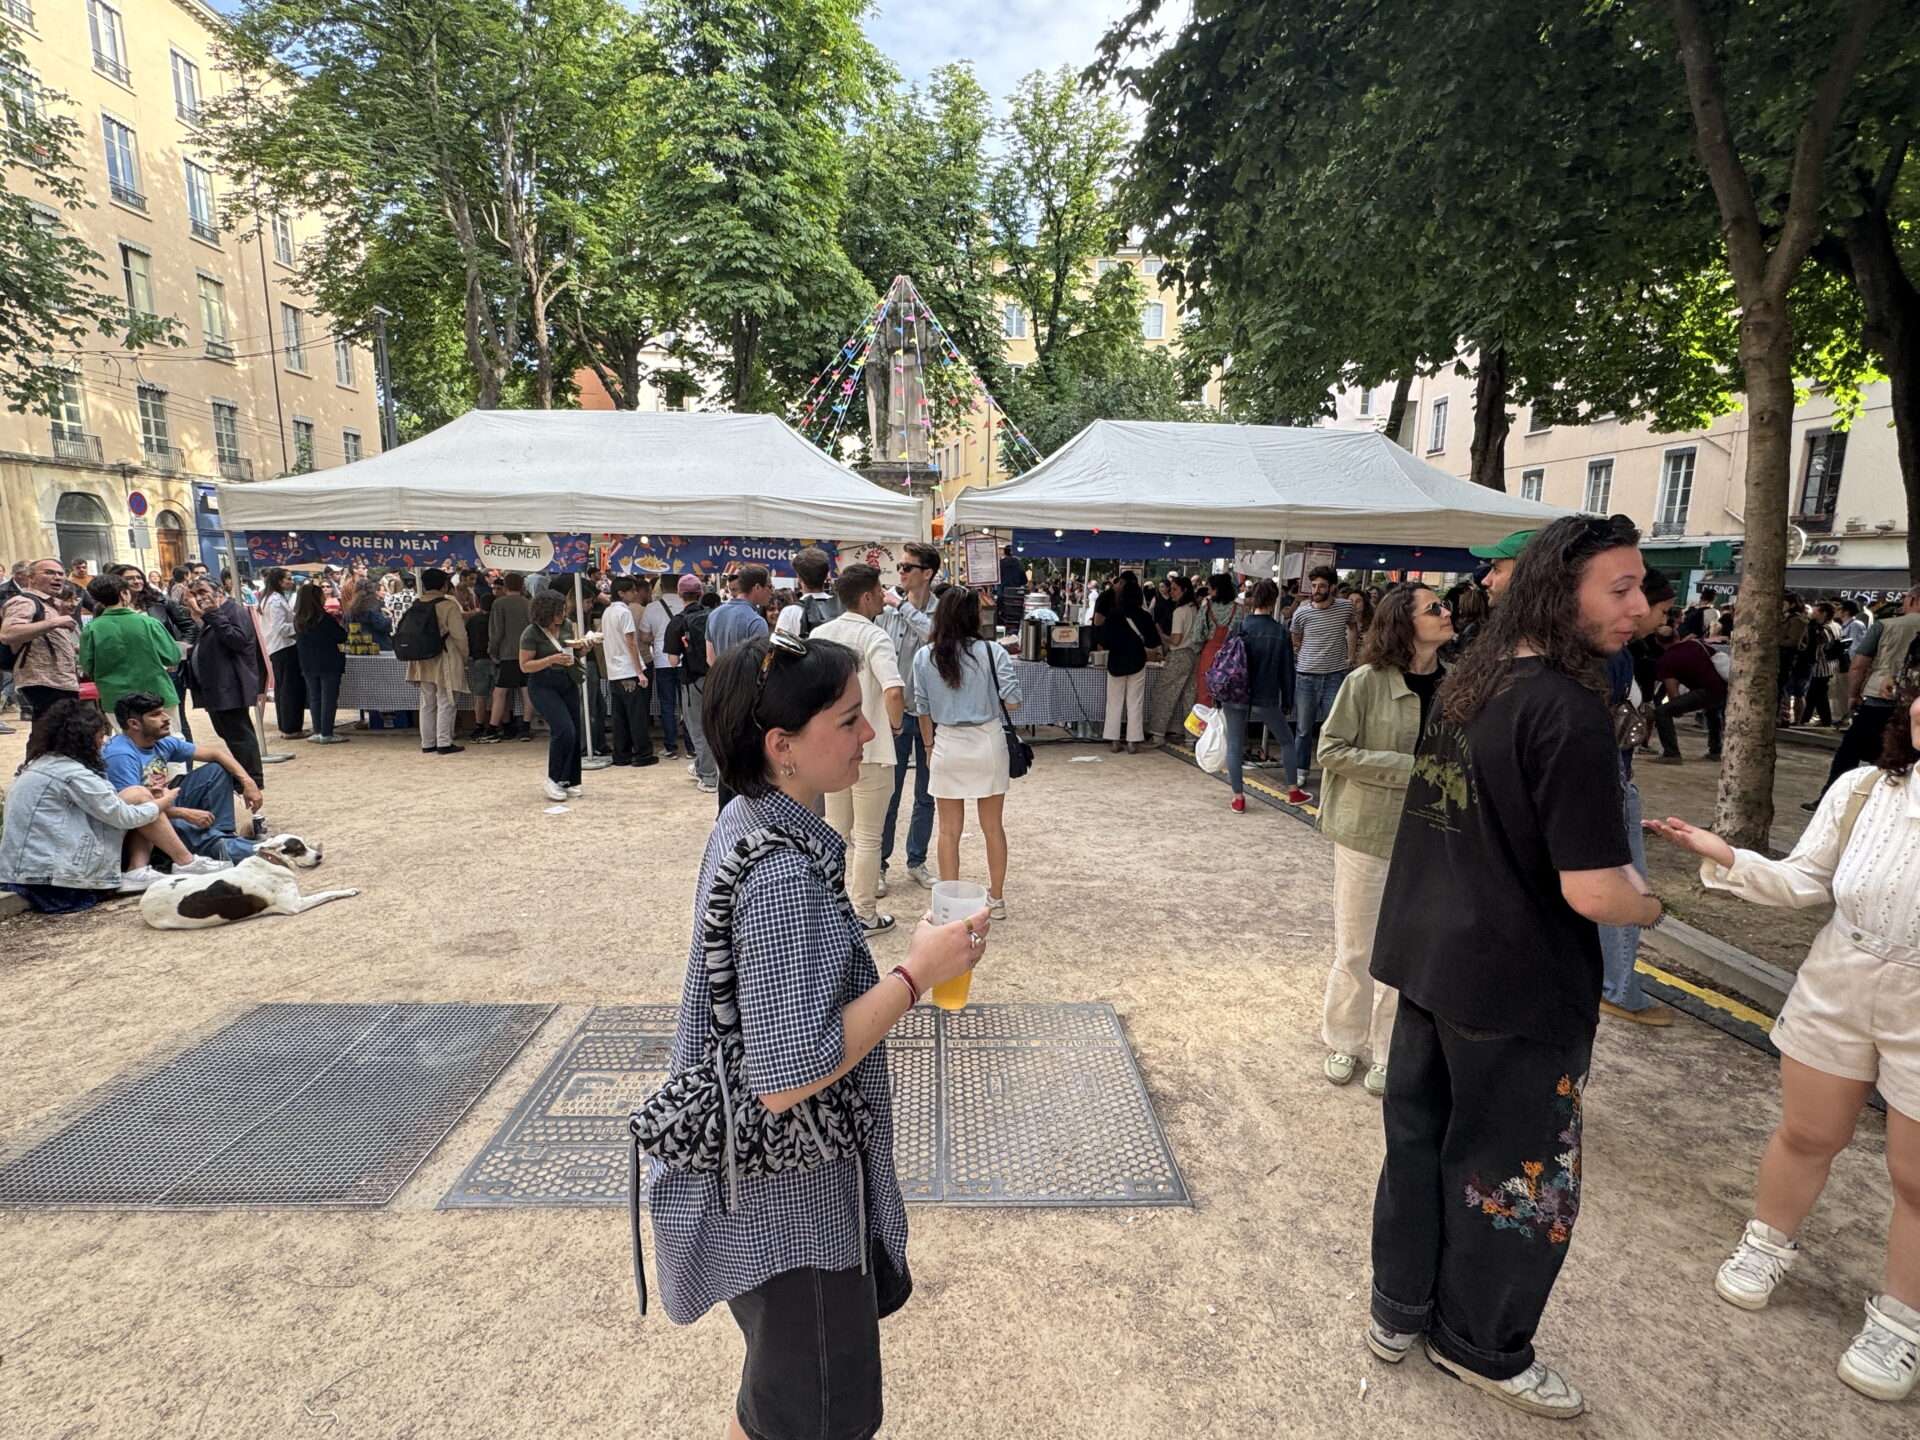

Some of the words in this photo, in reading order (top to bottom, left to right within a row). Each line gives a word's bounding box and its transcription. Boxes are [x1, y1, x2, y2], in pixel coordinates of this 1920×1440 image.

[339, 535, 394, 549] GREEN
[399, 538, 440, 551] MEAT
[483, 543, 516, 558] GREEN
[517, 546, 541, 560] MEAT
[708, 545, 738, 557] IV'S
[742, 547, 797, 561] CHICKE
